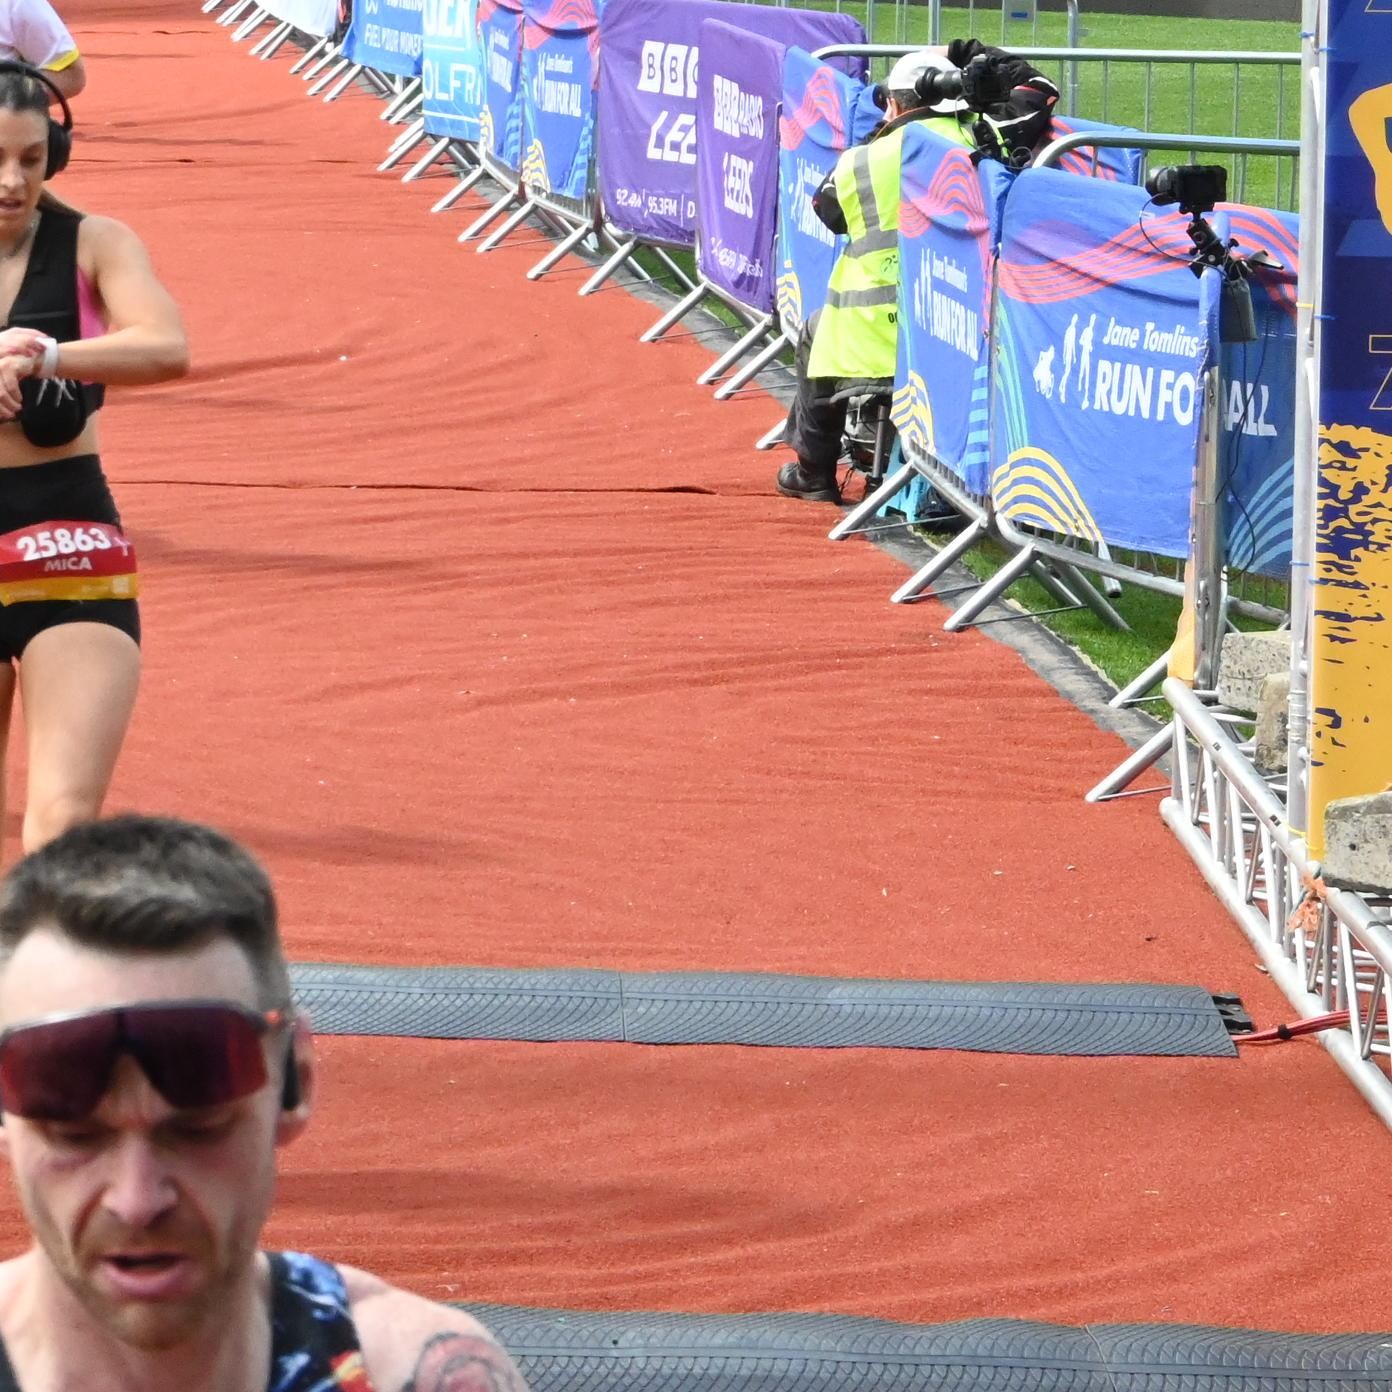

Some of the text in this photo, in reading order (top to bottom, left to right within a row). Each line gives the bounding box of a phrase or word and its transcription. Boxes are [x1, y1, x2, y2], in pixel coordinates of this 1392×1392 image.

[1102, 316, 1140, 348] Jane
[1093, 359, 1154, 420] RUN
[17, 527, 113, 562] 25863
[44, 557, 93, 572] MICA
